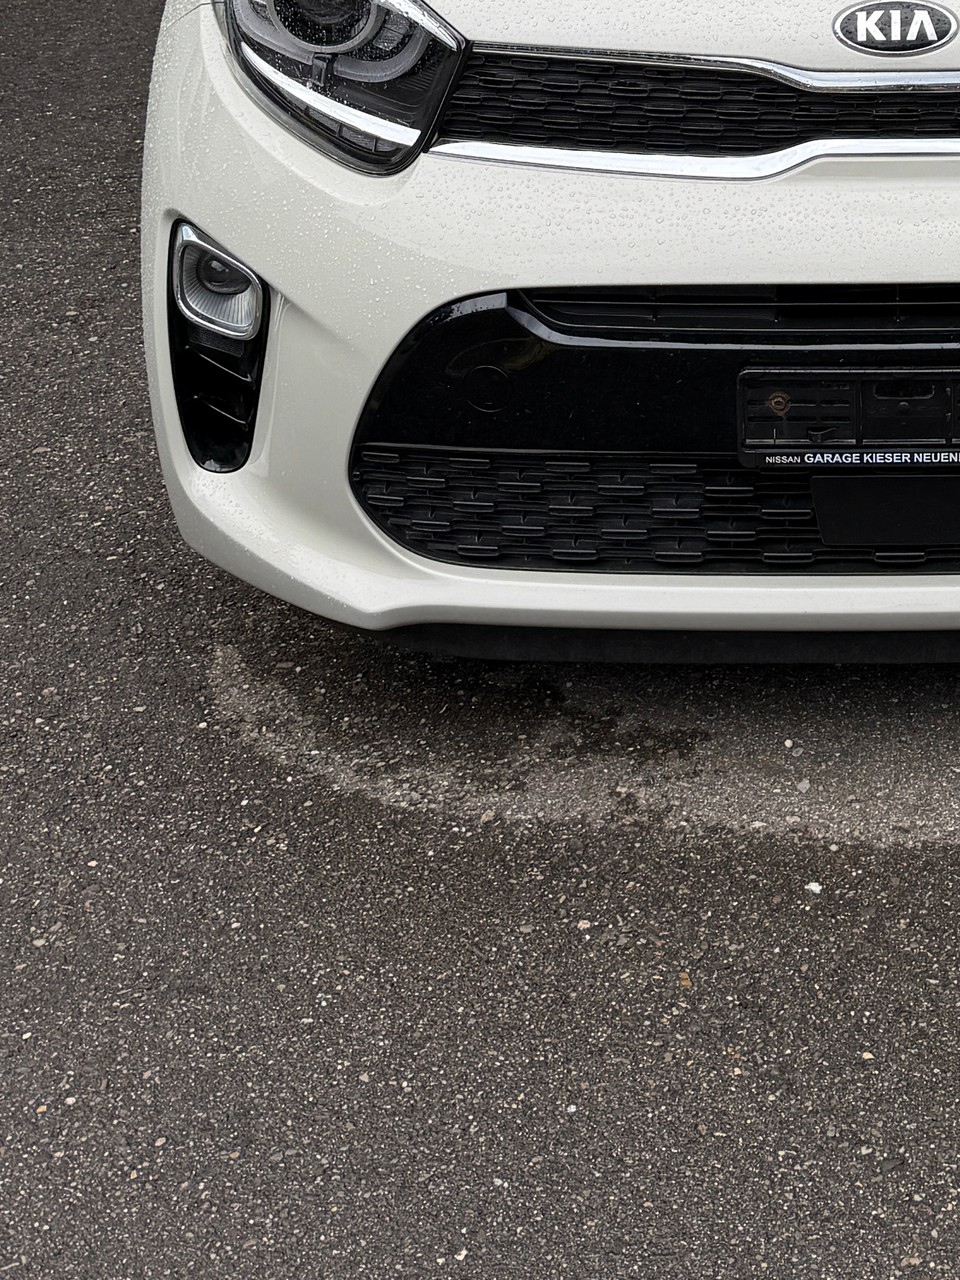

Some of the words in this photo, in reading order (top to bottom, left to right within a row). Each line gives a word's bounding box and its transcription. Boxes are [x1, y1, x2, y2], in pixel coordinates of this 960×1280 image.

[855, 9, 938, 41] KIA
[765, 455, 800, 464] NISSAN
[804, 453, 861, 464] GARAGE
[863, 453, 911, 463] KIESER
